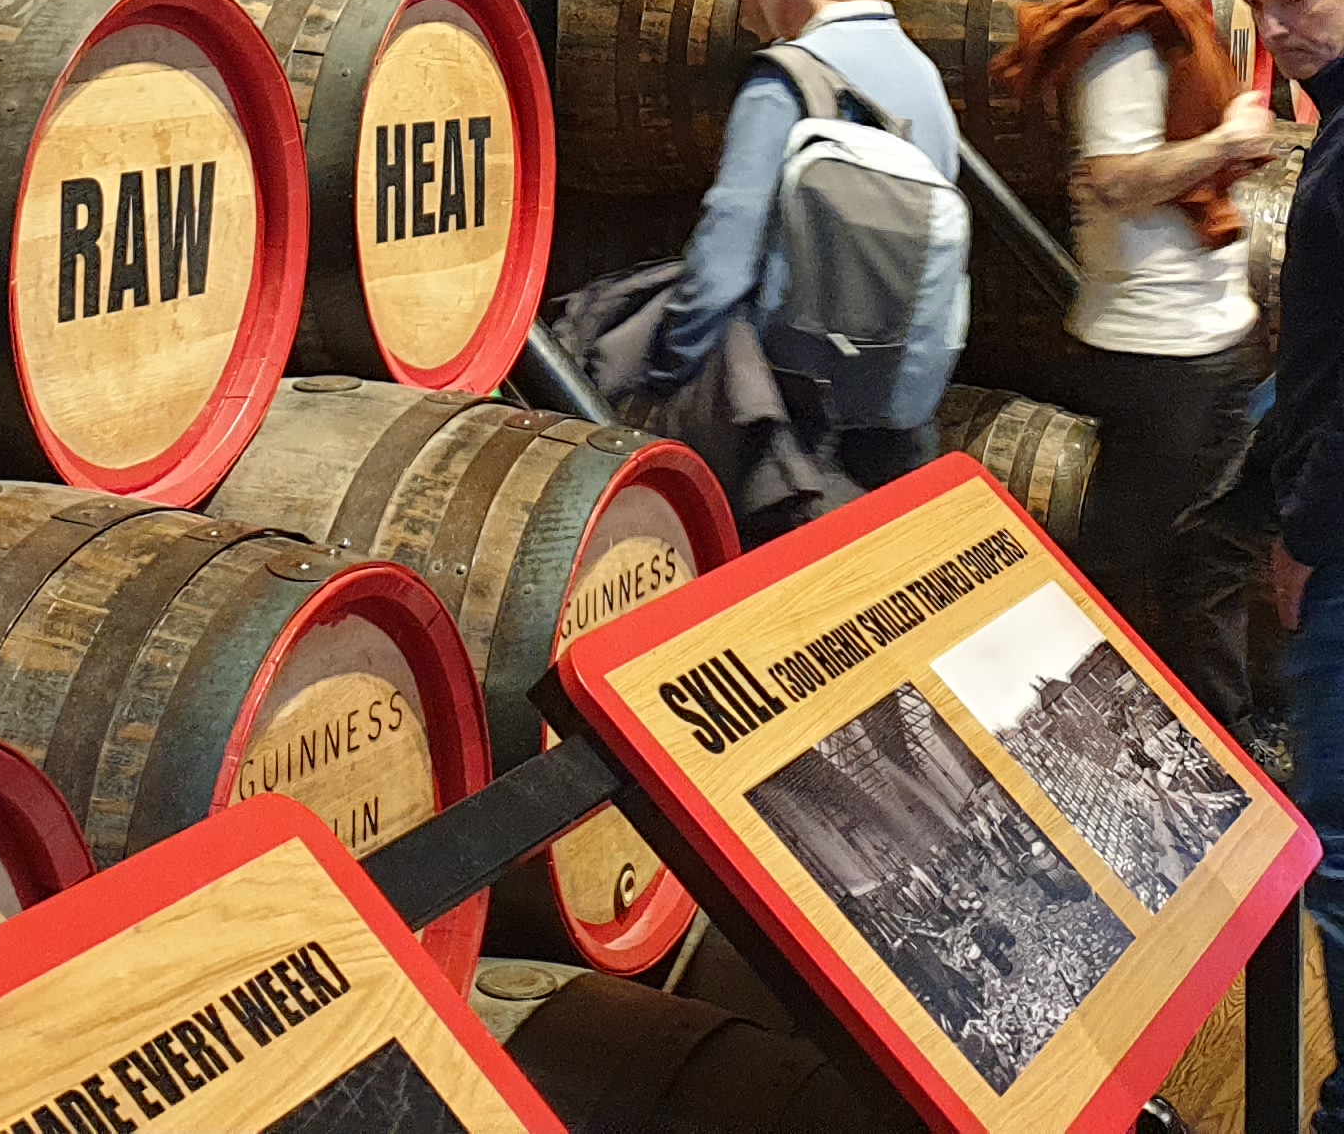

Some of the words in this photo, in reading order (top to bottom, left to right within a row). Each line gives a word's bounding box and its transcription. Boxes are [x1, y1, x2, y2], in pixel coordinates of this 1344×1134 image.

[57, 160, 217, 323] RAW
[374, 116, 492, 245] HEAT
[560, 547, 676, 639] GUINNESS
[658, 649, 788, 755] SKILL
[767, 650, 827, 703] (300
[805, 619, 877, 680] HIGHLY
[856, 589, 927, 647] SKILLED
[906, 560, 976, 615] TRAINED
[956, 528, 1029, 584] COOPERS)
[238, 690, 403, 801] GUINNESS
[109, 1003, 245, 1121] EVERY
[220, 941, 351, 1048] WEEK)
